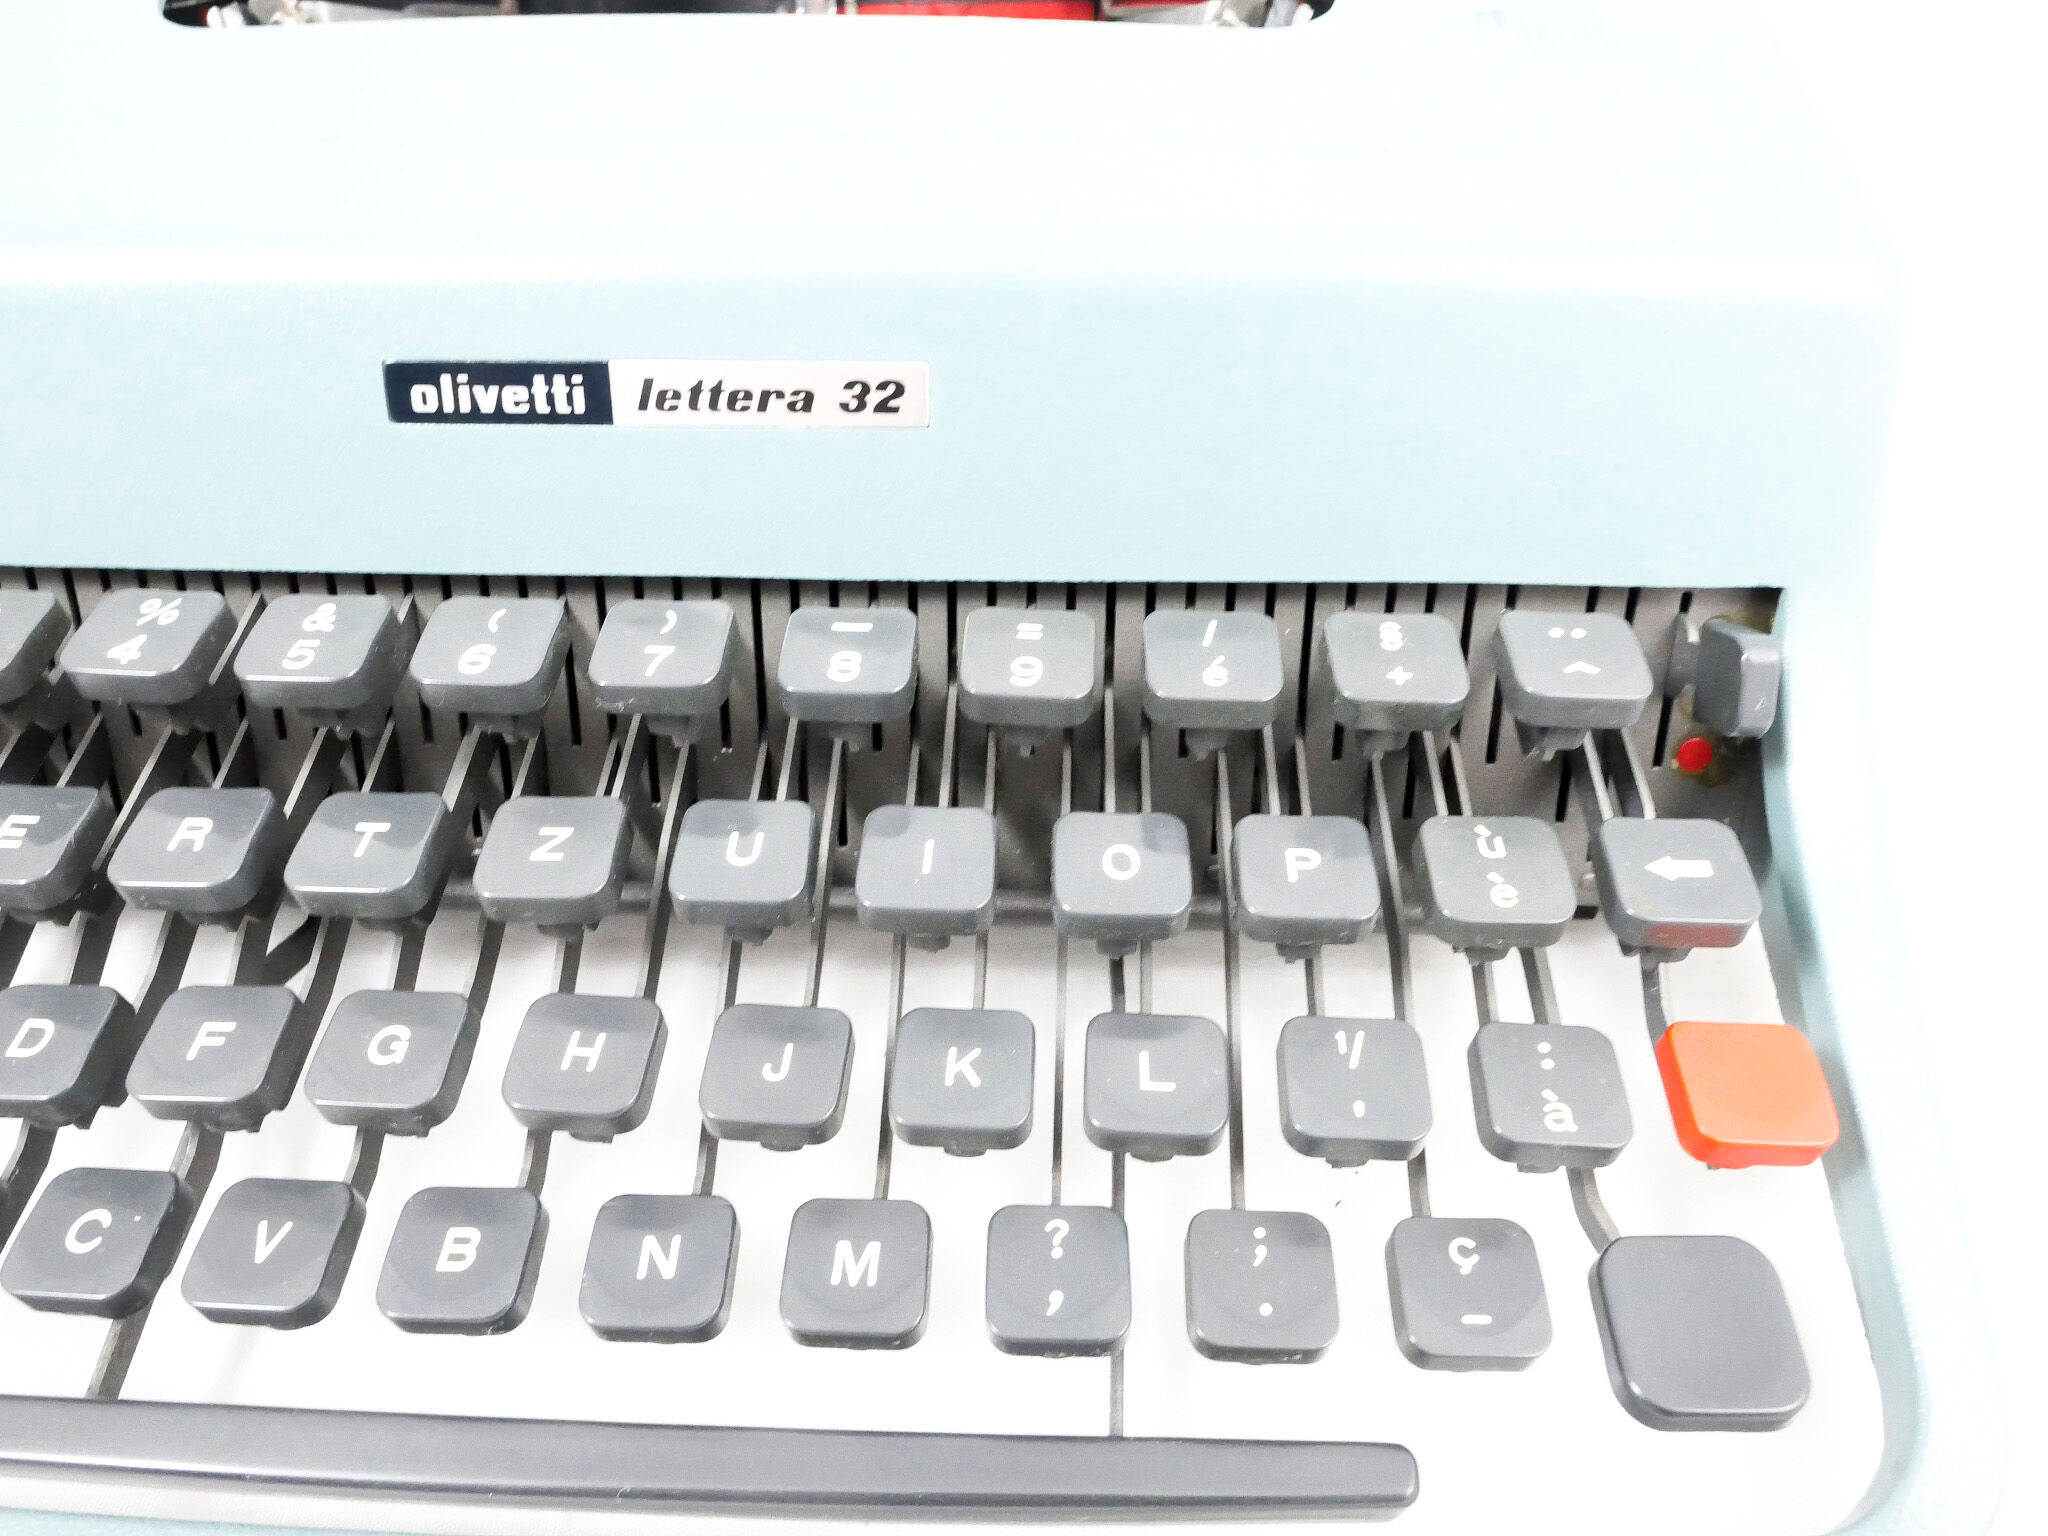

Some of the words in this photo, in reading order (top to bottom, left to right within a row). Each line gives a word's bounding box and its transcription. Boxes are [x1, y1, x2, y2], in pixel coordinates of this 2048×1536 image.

[410, 373, 586, 415] olivetti
[638, 378, 815, 413] lettera
[839, 380, 906, 414] 32
[135, 597, 183, 627] %
[301, 602, 337, 633] &
[487, 608, 505, 633] (
[659, 609, 678, 635] )
[106, 634, 143, 665] 4
[1015, 622, 1044, 641] =
[1201, 619, 1218, 648] /
[281, 639, 321, 670] 5
[457, 643, 497, 675] 6
[643, 644, 676, 677] 7
[826, 650, 863, 683] 8
[1008, 655, 1044, 688] 9
[1201, 655, 1229, 688] é
[1385, 665, 1414, 686] +
[0, 814, 41, 850] E
[166, 816, 214, 853] R
[352, 821, 392, 859] T
[528, 826, 575, 862] Z
[725, 830, 765, 867] U
[1101, 843, 1141, 881] O
[1284, 847, 1322, 884] P
[1486, 871, 1520, 909] è
[4, 1017, 55, 1058] D
[185, 1021, 237, 1061] F
[367, 1024, 412, 1066] G
[560, 1030, 607, 1073] H
[1536, 1041, 1555, 1071] :
[761, 1042, 794, 1082] J
[943, 1046, 982, 1088] K
[1138, 1050, 1177, 1092] L
[1541, 1088, 1579, 1133] à
[64, 1208, 113, 1255] C
[254, 1219, 293, 1264] V
[435, 1226, 482, 1273] B
[1044, 1218, 1070, 1260] ?
[1252, 1226, 1268, 1267] ;
[636, 1234, 682, 1281] N
[830, 1239, 882, 1288] M
[1448, 1236, 1481, 1276] ç
[1045, 1289, 1065, 1317] ,
